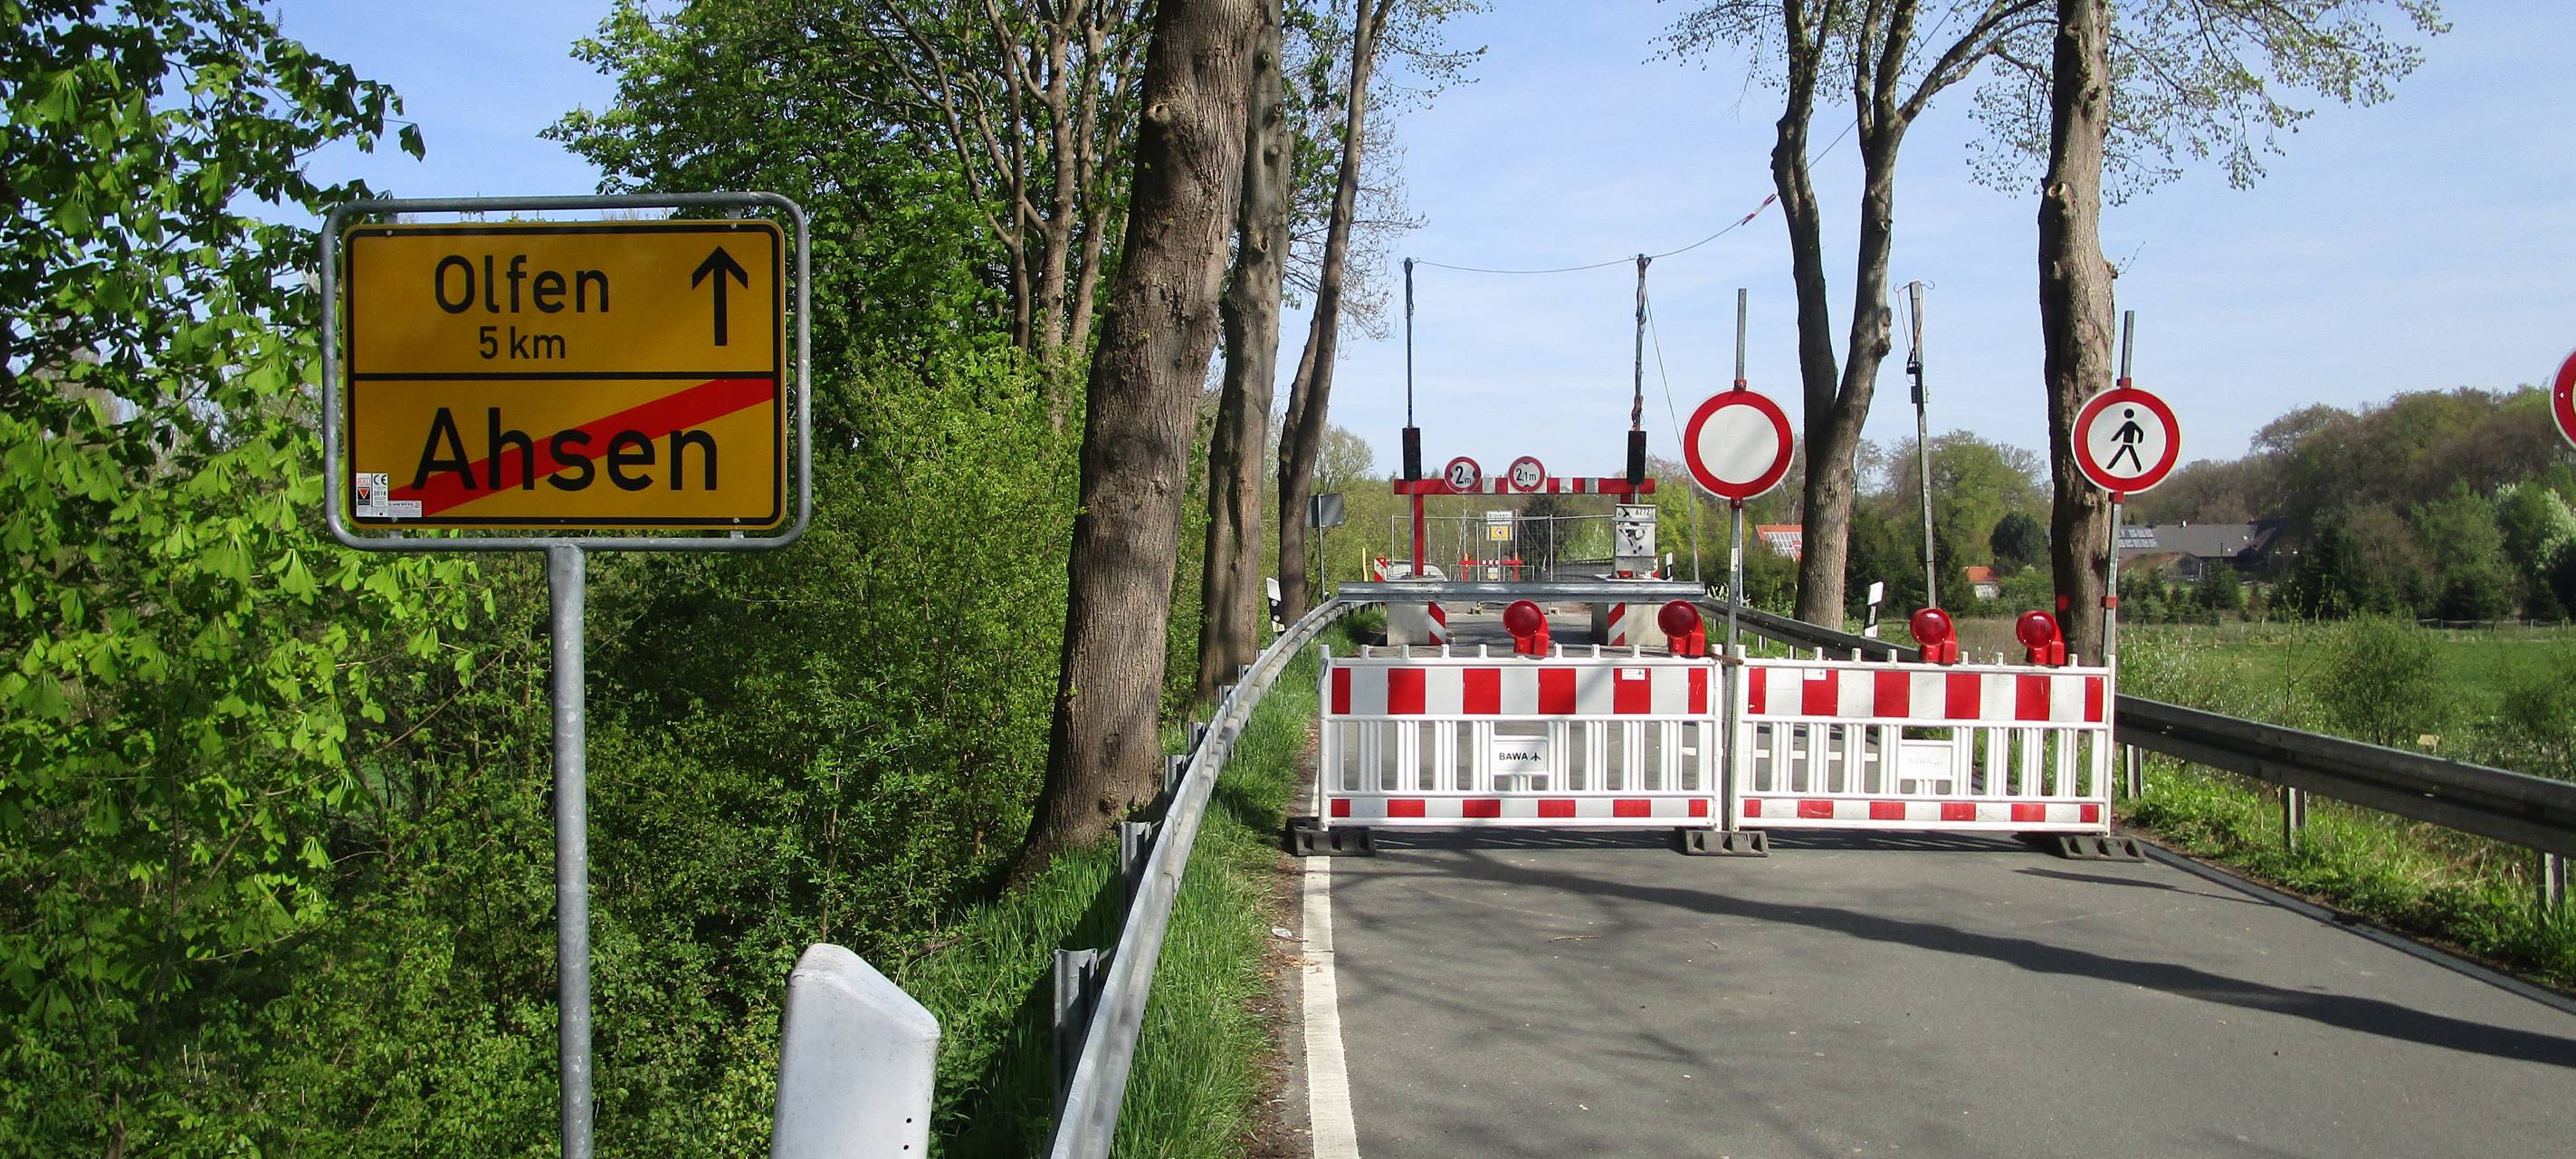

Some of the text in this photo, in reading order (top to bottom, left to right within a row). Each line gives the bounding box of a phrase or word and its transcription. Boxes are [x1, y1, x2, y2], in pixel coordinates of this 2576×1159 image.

[435, 254, 609, 314] Olfen
[479, 326, 566, 359] 5 km
[412, 407, 718, 491] Ahsen
[1499, 752, 1529, 761] BAWA
